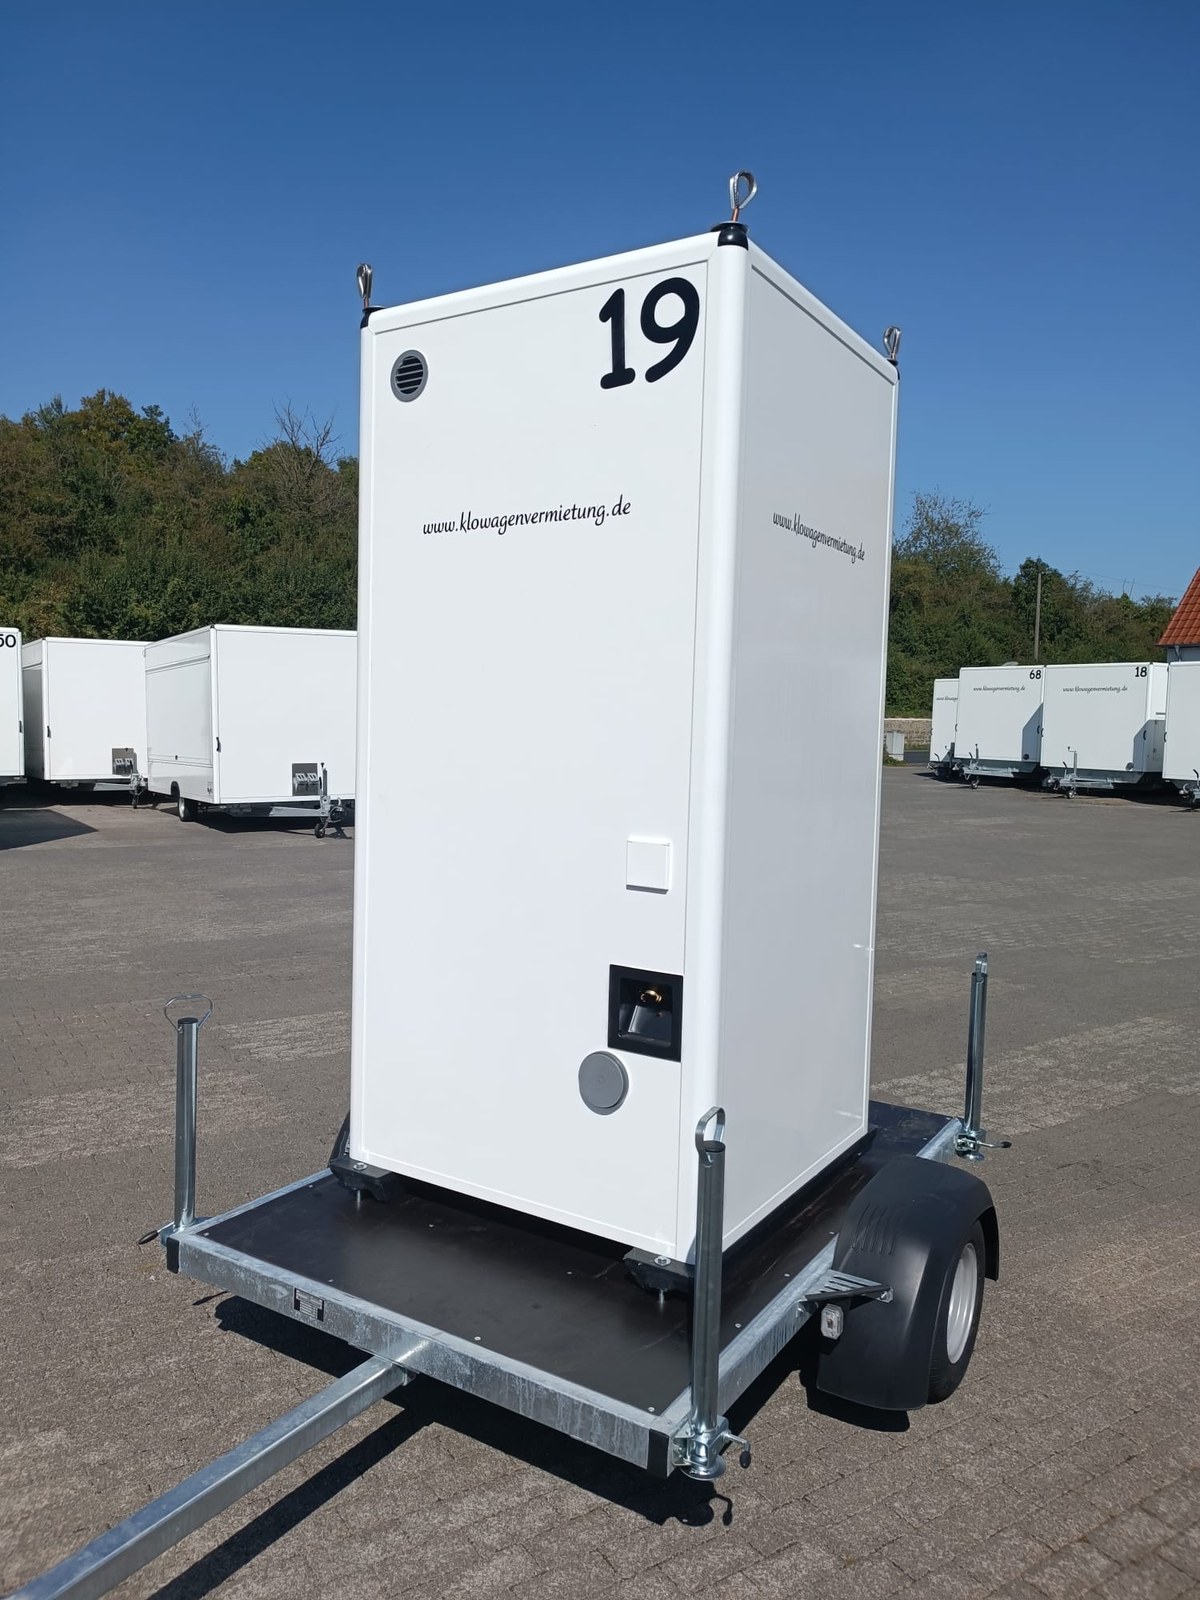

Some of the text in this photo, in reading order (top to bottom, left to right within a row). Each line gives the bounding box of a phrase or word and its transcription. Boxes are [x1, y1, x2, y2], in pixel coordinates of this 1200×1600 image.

[598, 277, 700, 390] 19
[423, 494, 631, 535] www.klowagenvermietung.de
[772, 511, 866, 564] www.klowagenvermietung.de
[1029, 669, 1042, 680] 68
[1134, 666, 1148, 678] 18
